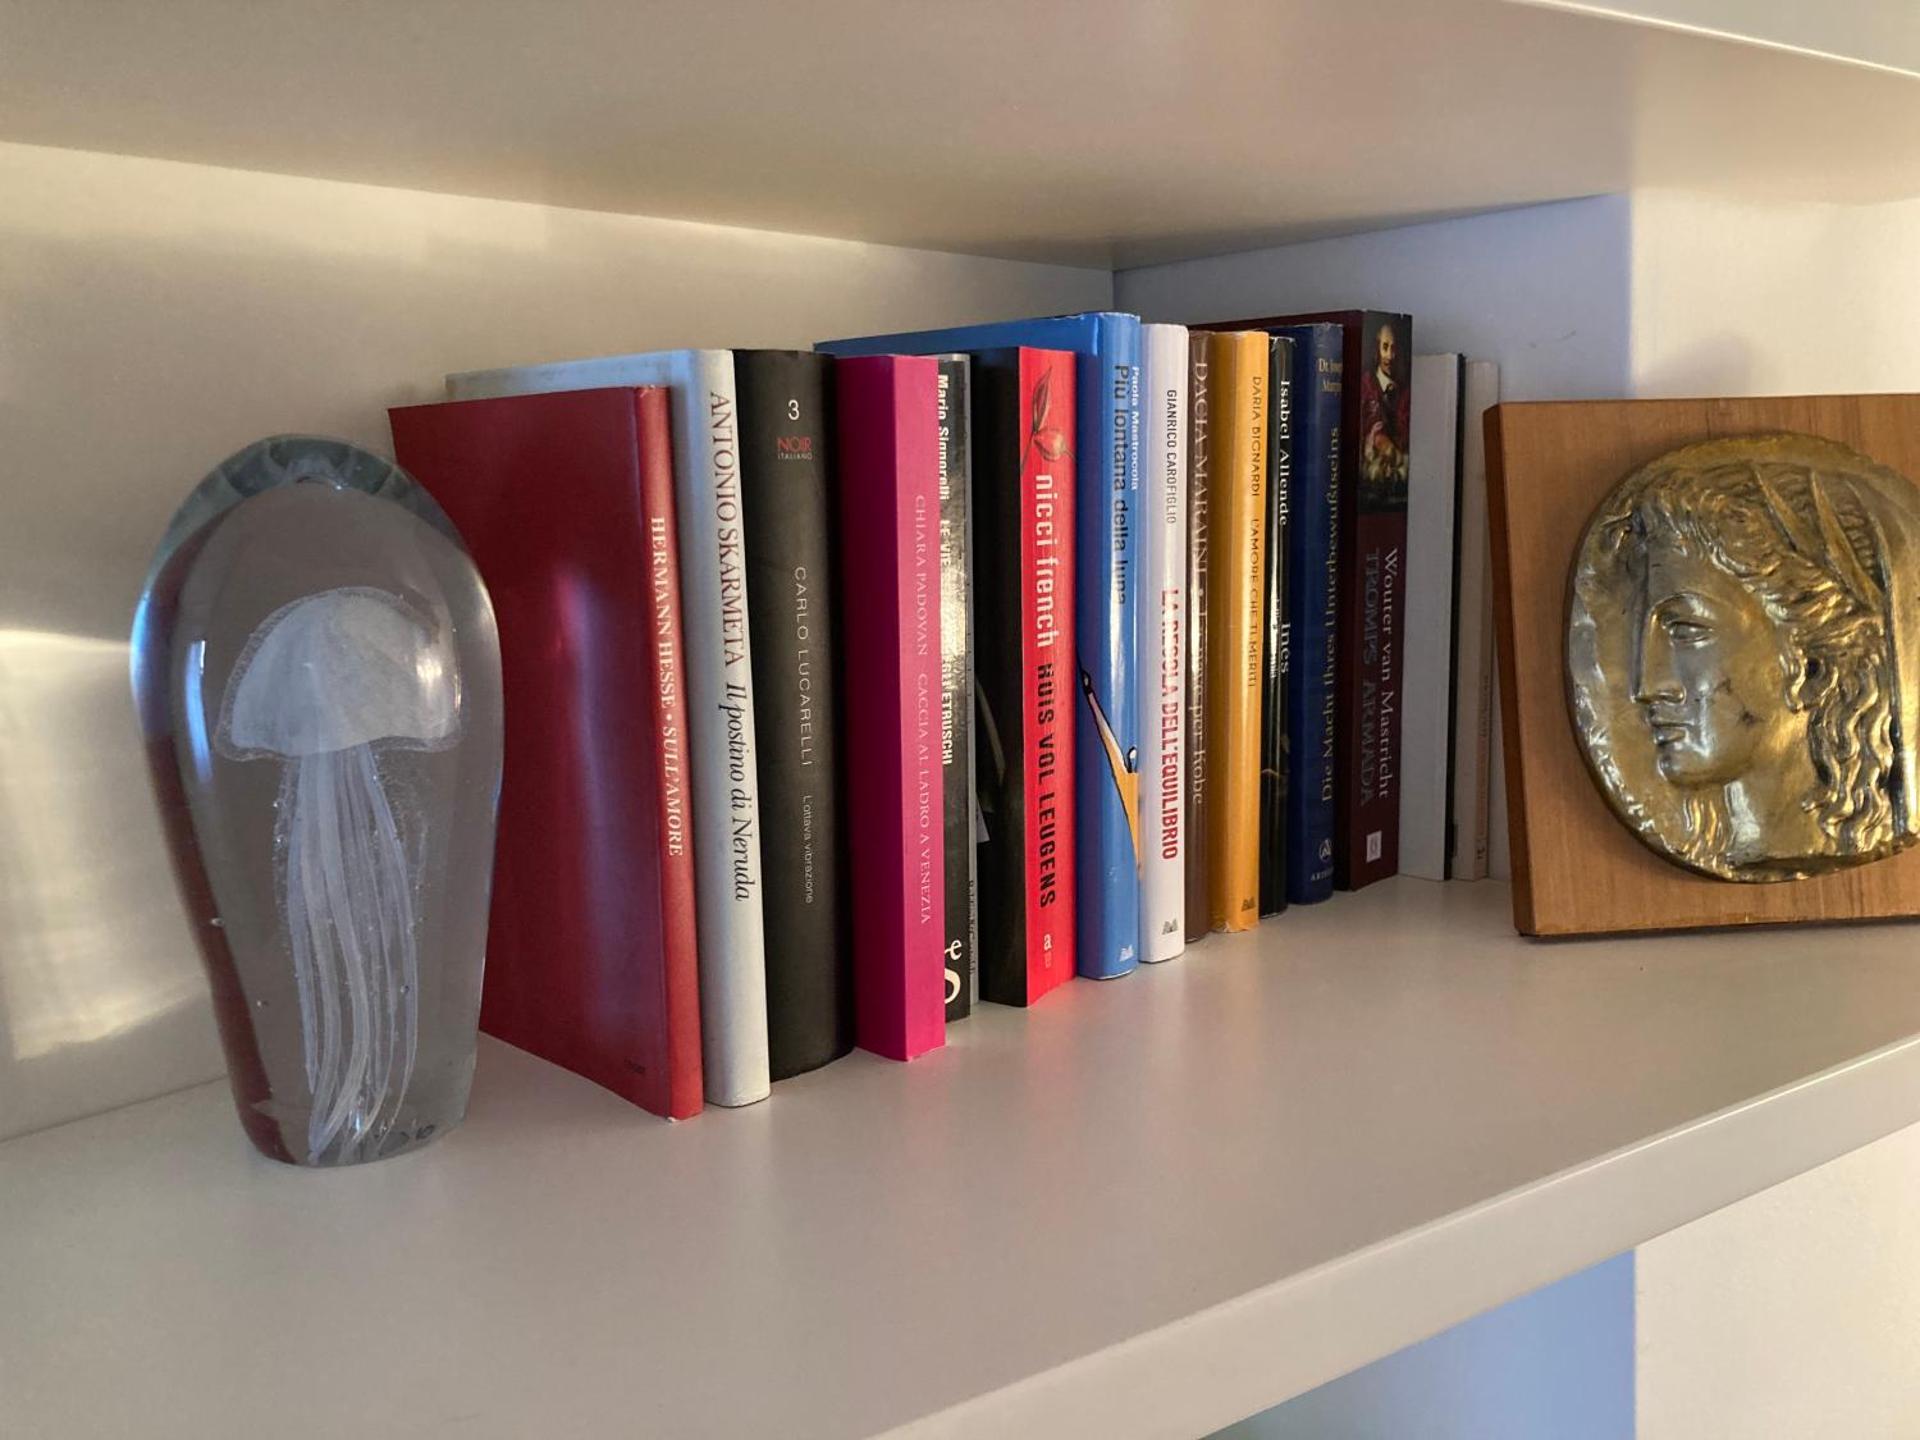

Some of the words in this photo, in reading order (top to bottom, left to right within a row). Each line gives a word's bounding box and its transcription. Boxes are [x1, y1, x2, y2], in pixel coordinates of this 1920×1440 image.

[788, 399, 800, 420] 3
[937, 374, 949, 420] Mario
[1114, 365, 1130, 399] Più
[1131, 366, 1140, 406] Paola
[1194, 363, 1208, 443] DACIA
[1252, 376, 1262, 419] DARIA
[1279, 380, 1290, 439] Isabel
[777, 437, 812, 452] NOIR
[1114, 409, 1129, 491] lontana
[1131, 411, 1140, 490] Mastrocola
[1166, 389, 1177, 448] GIANRICO
[710, 391, 737, 522] ANTONIO
[1165, 452, 1177, 524] CAROFIGLIO
[1251, 427, 1261, 497] BIGNARDI
[1279, 449, 1290, 525] Allende
[915, 495, 927, 567] CHIARA
[1036, 475, 1057, 546] nicci
[1114, 500, 1129, 551] della
[1194, 456, 1208, 572] MARAINI
[651, 517, 672, 635] HERMANN
[717, 527, 744, 667] SKARMETA
[795, 566, 809, 640] CARLO
[1036, 556, 1060, 648] french
[1382, 548, 1398, 634] Wouter
[916, 573, 928, 656] PADOVAN
[658, 642, 675, 708] HESSE
[726, 682, 747, 701] Il
[1037, 663, 1055, 725] HUIS
[1381, 643, 1393, 681] van
[798, 650, 813, 765] LUCARELLI
[918, 673, 929, 738] CACCIA
[941, 692, 953, 765] ETRUSCHI
[1322, 694, 1335, 758] Macht
[718, 704, 750, 782] postino
[919, 744, 929, 761] AL
[1038, 734, 1055, 785] VOL
[1360, 680, 1377, 806] ARMADA
[1379, 691, 1394, 799] Mastricht
[662, 726, 682, 856] SULL'AMORE
[730, 788, 752, 810] di
[919, 769, 930, 828] LADRO
[1161, 702, 1179, 860] DELL'EQUILIBRIO
[1322, 766, 1333, 801] Die
[803, 795, 813, 841] L'ottava
[920, 833, 931, 844] A
[1038, 792, 1056, 908] LEUGENS
[732, 818, 755, 902] Neruda
[804, 843, 814, 904] vibrazione
[920, 849, 931, 924] VENEZIA
